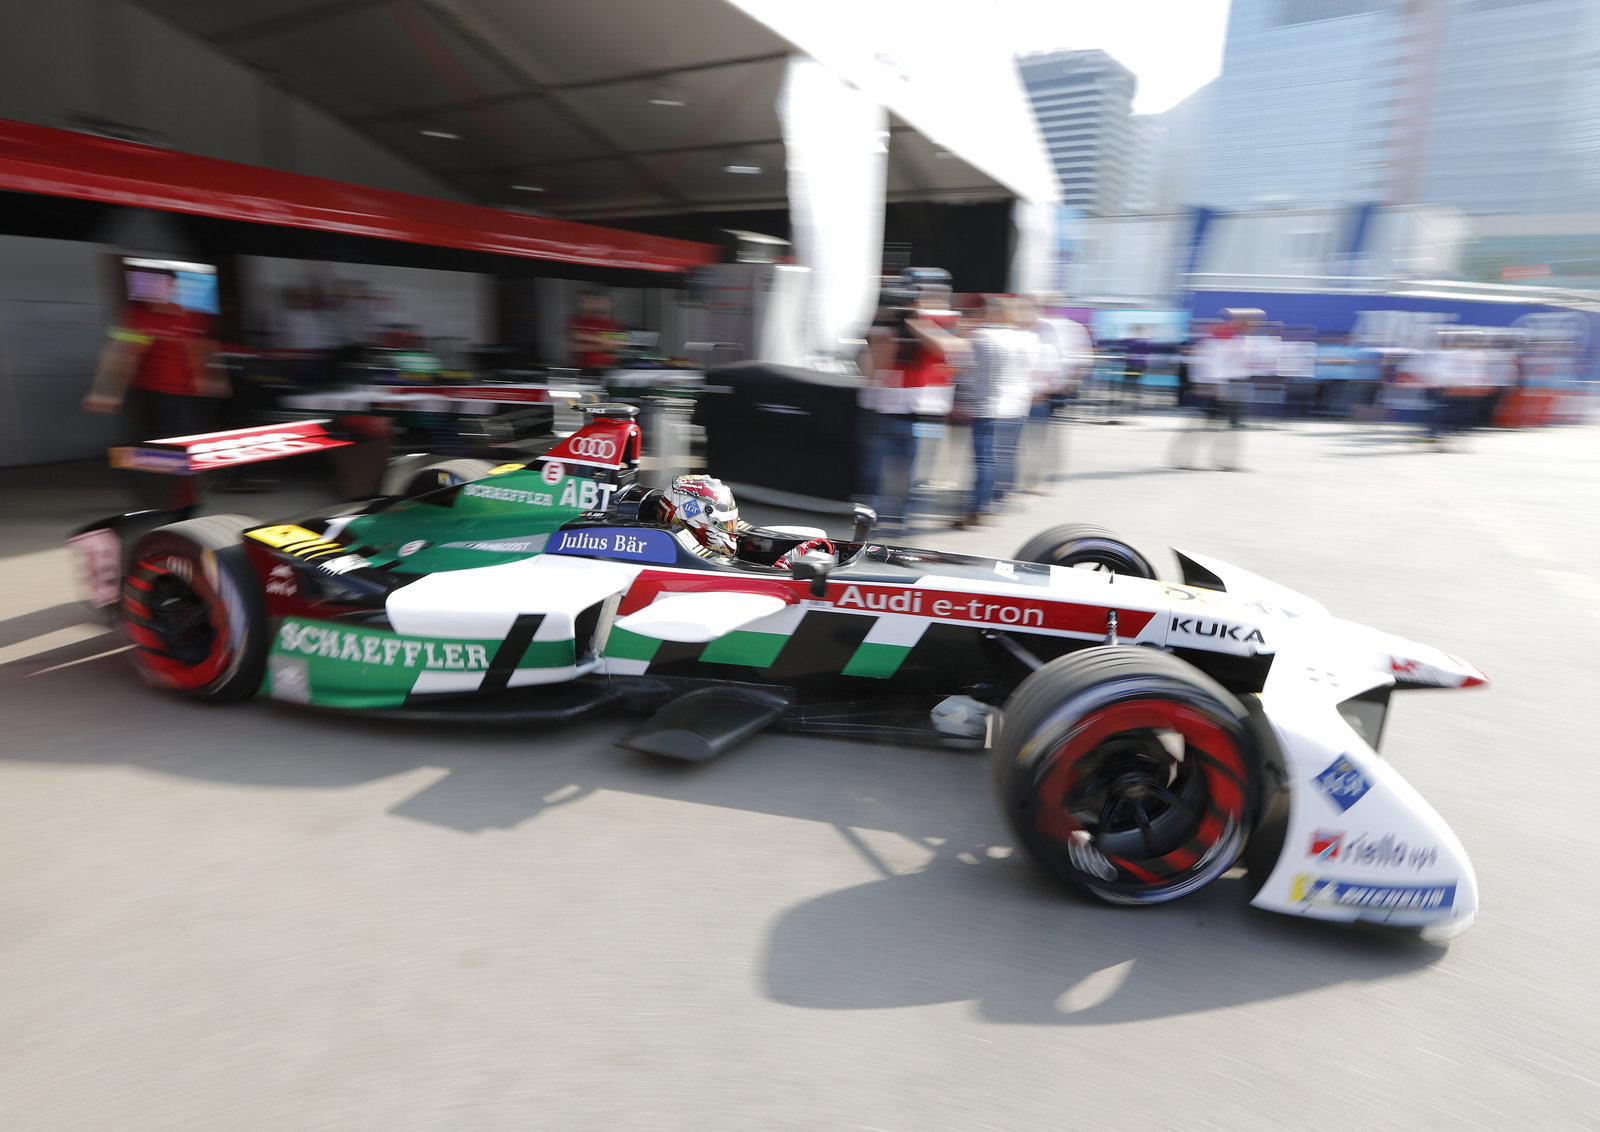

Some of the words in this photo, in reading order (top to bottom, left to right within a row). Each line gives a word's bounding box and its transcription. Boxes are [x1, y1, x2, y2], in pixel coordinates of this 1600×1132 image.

[463, 483, 554, 507] SCHAEFFLER
[559, 479, 618, 512] ABT
[684, 503, 700, 514] LGT
[559, 532, 608, 552] Julius
[613, 534, 648, 554] Bär
[837, 585, 923, 613] Audi
[932, 598, 1044, 626] e-tron
[279, 621, 490, 669] SCHAEFFLER
[1170, 616, 1266, 645] KUKA
